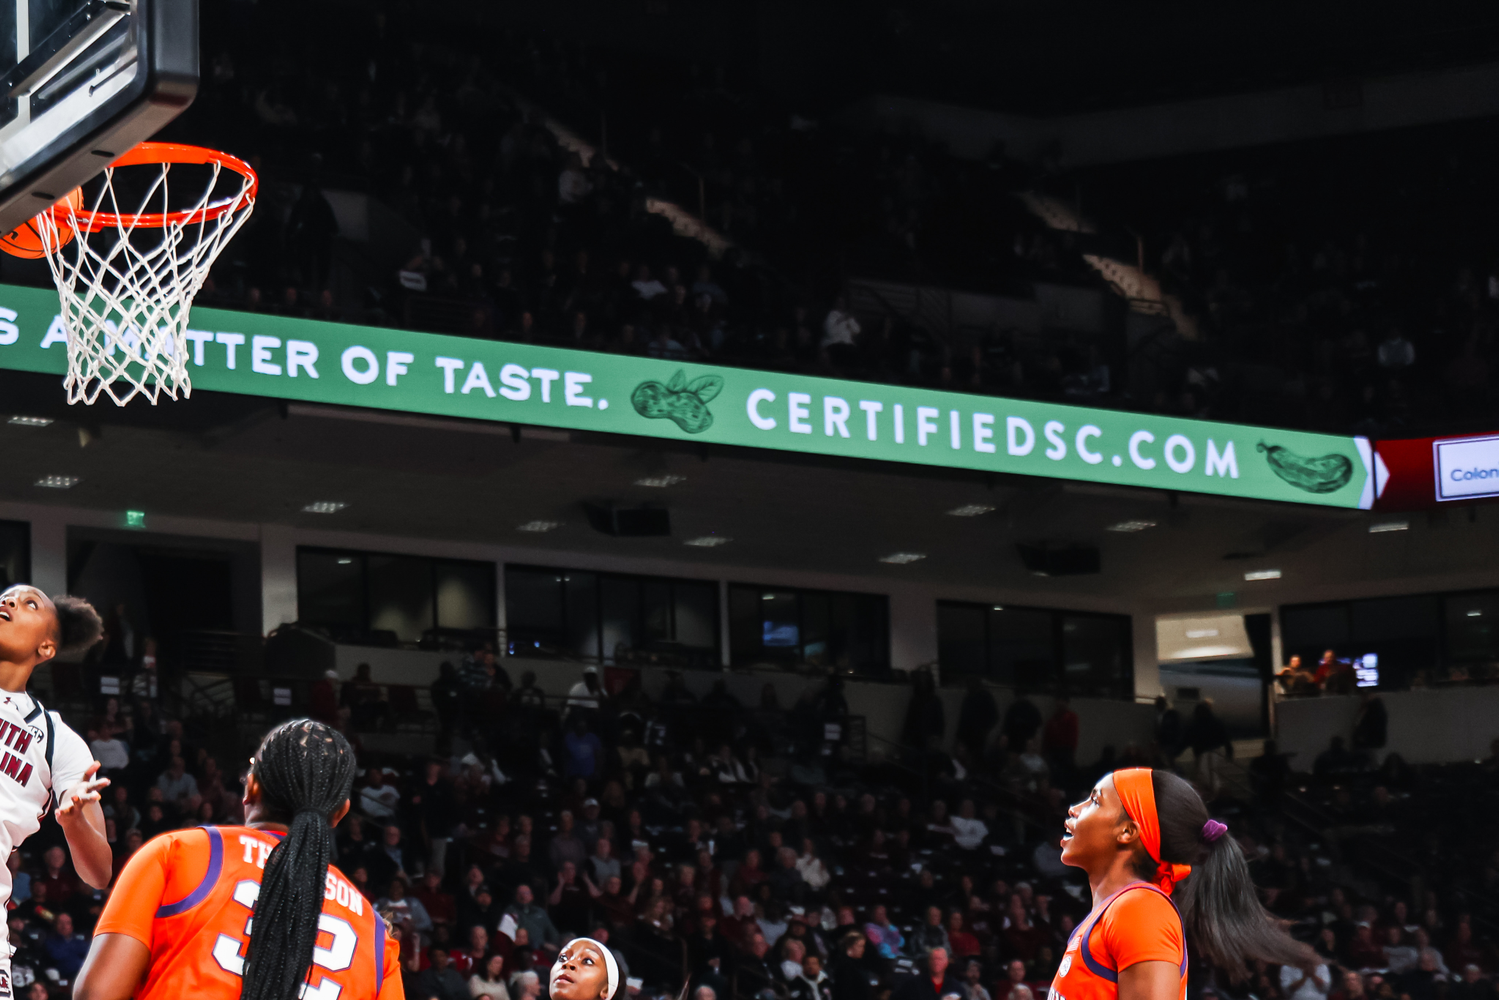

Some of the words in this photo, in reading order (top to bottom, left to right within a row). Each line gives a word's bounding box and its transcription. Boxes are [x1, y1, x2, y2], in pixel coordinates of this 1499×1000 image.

[341, 343, 416, 388] OF
[436, 356, 610, 411] TASTE.
[746, 387, 1240, 480] CERTIFIEDSC.COM
[1450, 467, 1499, 482] Colon
